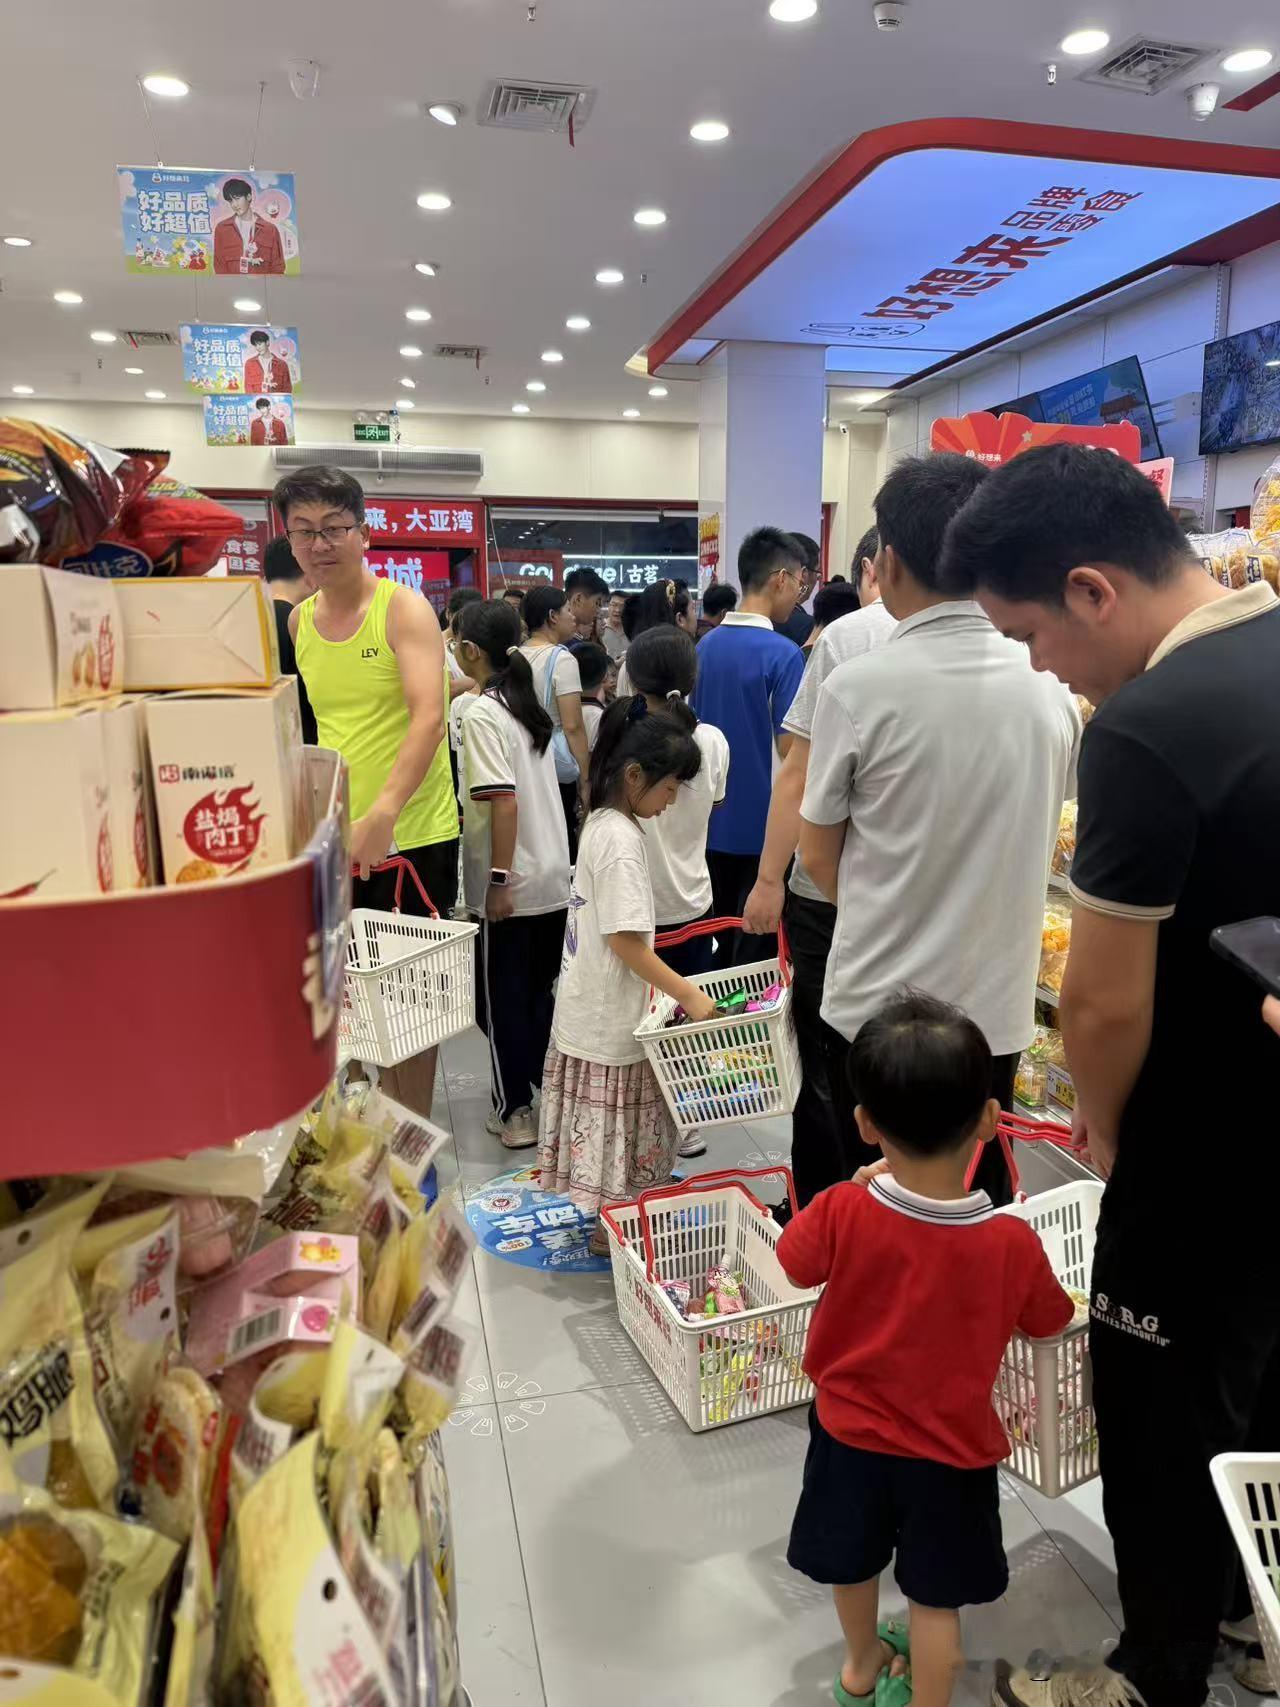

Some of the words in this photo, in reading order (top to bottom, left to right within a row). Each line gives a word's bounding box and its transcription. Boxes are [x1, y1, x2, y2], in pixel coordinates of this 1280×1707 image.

[137, 190, 209, 213] 好品质
[1000, 185, 1088, 230] 品牌
[1050, 190, 1143, 232] 零食
[139, 212, 213, 234] 好超值
[860, 233, 1074, 320] 好想来
[192, 338, 241, 353] 好品质
[194, 353, 243, 368] 好超值
[213, 404, 248, 416] 好品质
[214, 415, 249, 427] 好超值
[977, 453, 1002, 463] 好想来
[627, 564, 660, 584] 古茗
[361, 647, 379, 659] LEV
[194, 806, 240, 832] 盐焗
[205, 825, 246, 850] 肉丁
